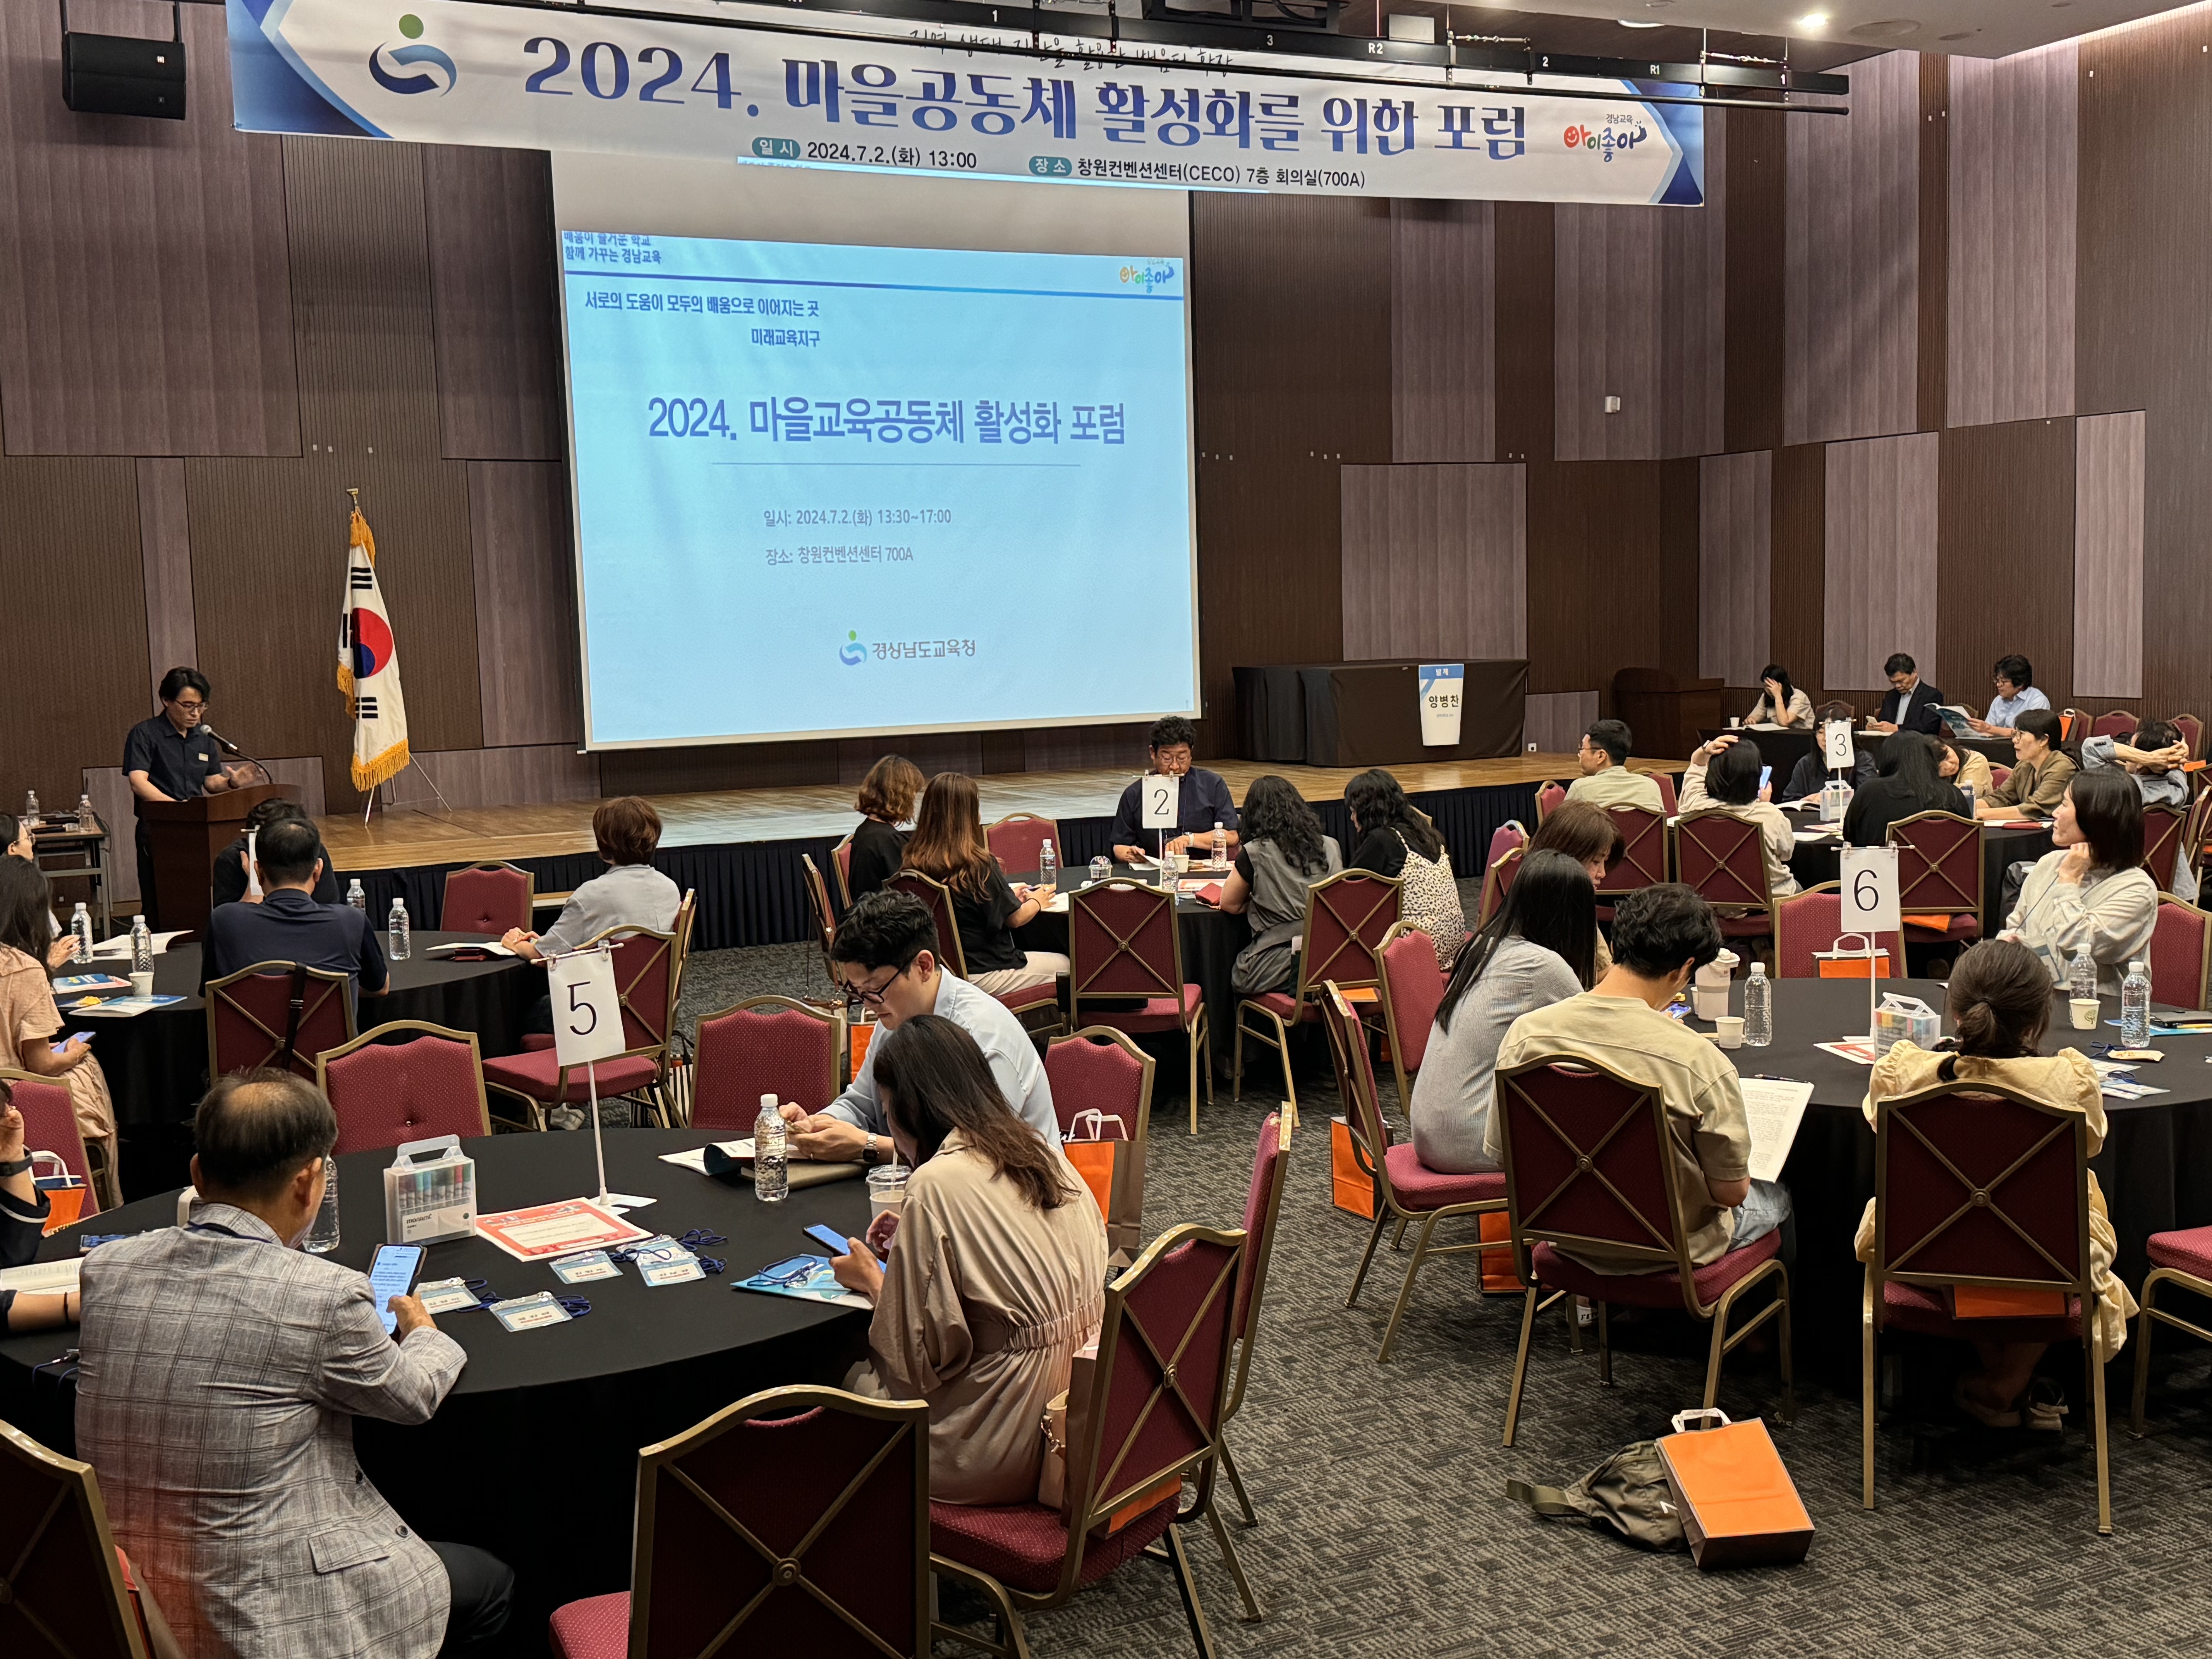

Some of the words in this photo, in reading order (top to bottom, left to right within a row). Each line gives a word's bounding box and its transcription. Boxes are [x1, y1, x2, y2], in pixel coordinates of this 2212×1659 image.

[992, 10, 998, 22] 1
[1267, 34, 1273, 46] 3
[1368, 43, 1383, 54] R2
[1542, 56, 1549, 67] 2
[1650, 64, 1660, 75] R1
[1781, 74, 1785, 84] 1
[524, 37, 759, 117] 2024.
[782, 58, 1076, 139] 마을공동체
[1095, 81, 1305, 151] 활성화를
[1321, 98, 1419, 156] 위한
[1434, 105, 1525, 160] 포럼
[1606, 114, 1633, 124] 경남교육
[807, 141, 921, 167] 2024.7.2.(화)
[929, 150, 977, 168] 13:00
[1078, 158, 1240, 184] 창원컨벤션센터(CECO)
[1247, 167, 1269, 185] 7층
[1276, 168, 1365, 189] 회의실(700A)
[565, 246, 585, 261] 함께
[589, 247, 619, 263] 가꾸는
[622, 248, 661, 264] 경남교육
[585, 291, 622, 310] 서로의
[626, 293, 663, 311] 도움이
[667, 294, 703, 313] 모두의
[707, 296, 755, 314] 배움으로
[758, 298, 804, 317] 이어지는
[807, 300, 819, 317] 곳
[751, 328, 820, 347] 미래교육지구
[648, 397, 737, 441] 2024.
[750, 397, 964, 443] 마을교육공동체
[974, 400, 1062, 445] 활성화
[1070, 403, 1125, 445] 포럼
[764, 510, 791, 527] 일시:
[796, 510, 872, 527] 2024.7.2.(화)
[878, 509, 951, 524] 13:30~17:00
[765, 548, 793, 566] 장소:
[798, 545, 882, 564] 창원컨벤션센터
[885, 547, 914, 561] 700A
[872, 639, 975, 660] 경상남도교육청
[1429, 694, 1459, 708] 양병찬
[1835, 733, 1847, 756] 3
[1154, 789, 1169, 815] 2
[1853, 869, 1879, 912] 6
[567, 981, 597, 1036] 5
